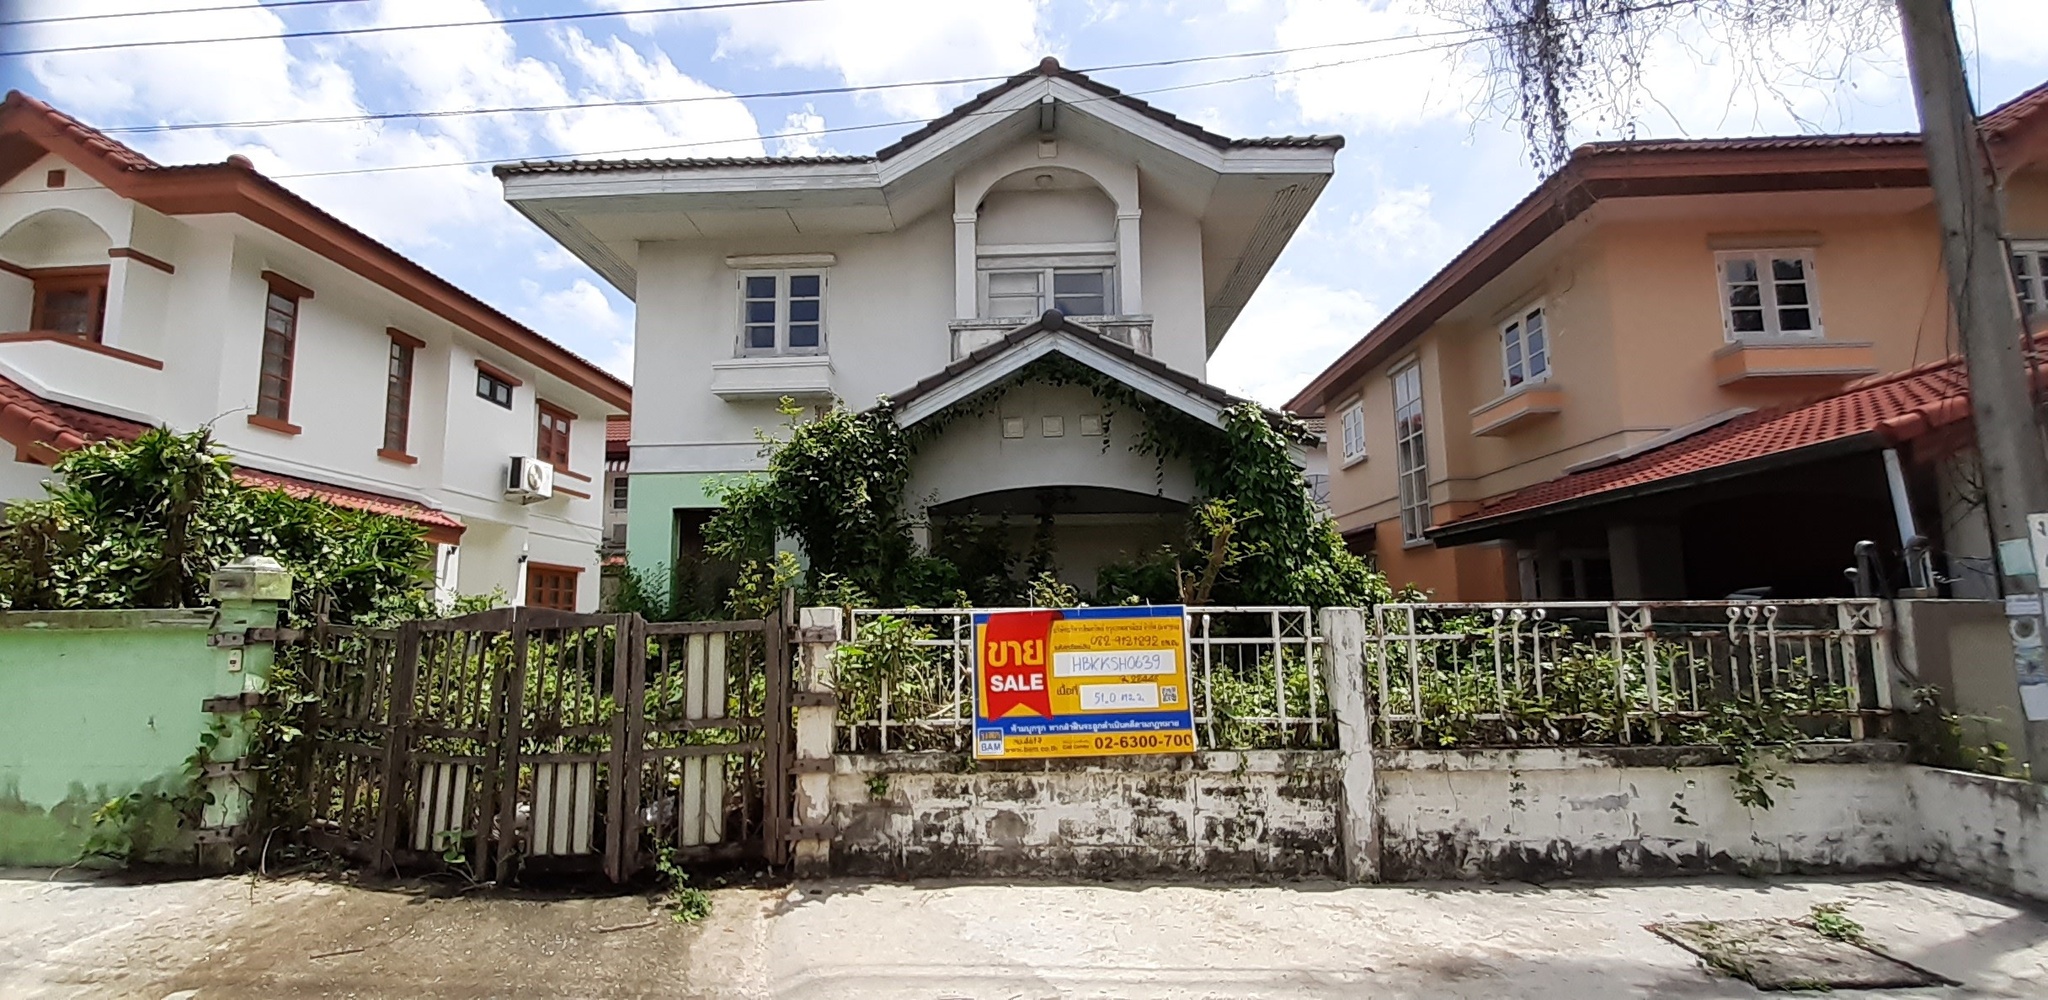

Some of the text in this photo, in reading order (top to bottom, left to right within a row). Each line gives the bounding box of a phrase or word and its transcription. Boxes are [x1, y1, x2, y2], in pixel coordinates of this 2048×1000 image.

[988, 639, 1044, 667] ขาย
[1072, 653, 1161, 672] HBKKSH0639
[990, 673, 1044, 692] SALE
[1094, 692, 1116, 704] 51.0
[981, 743, 1001, 752] BAM
[1094, 734, 1193, 749] 02-6300-700
